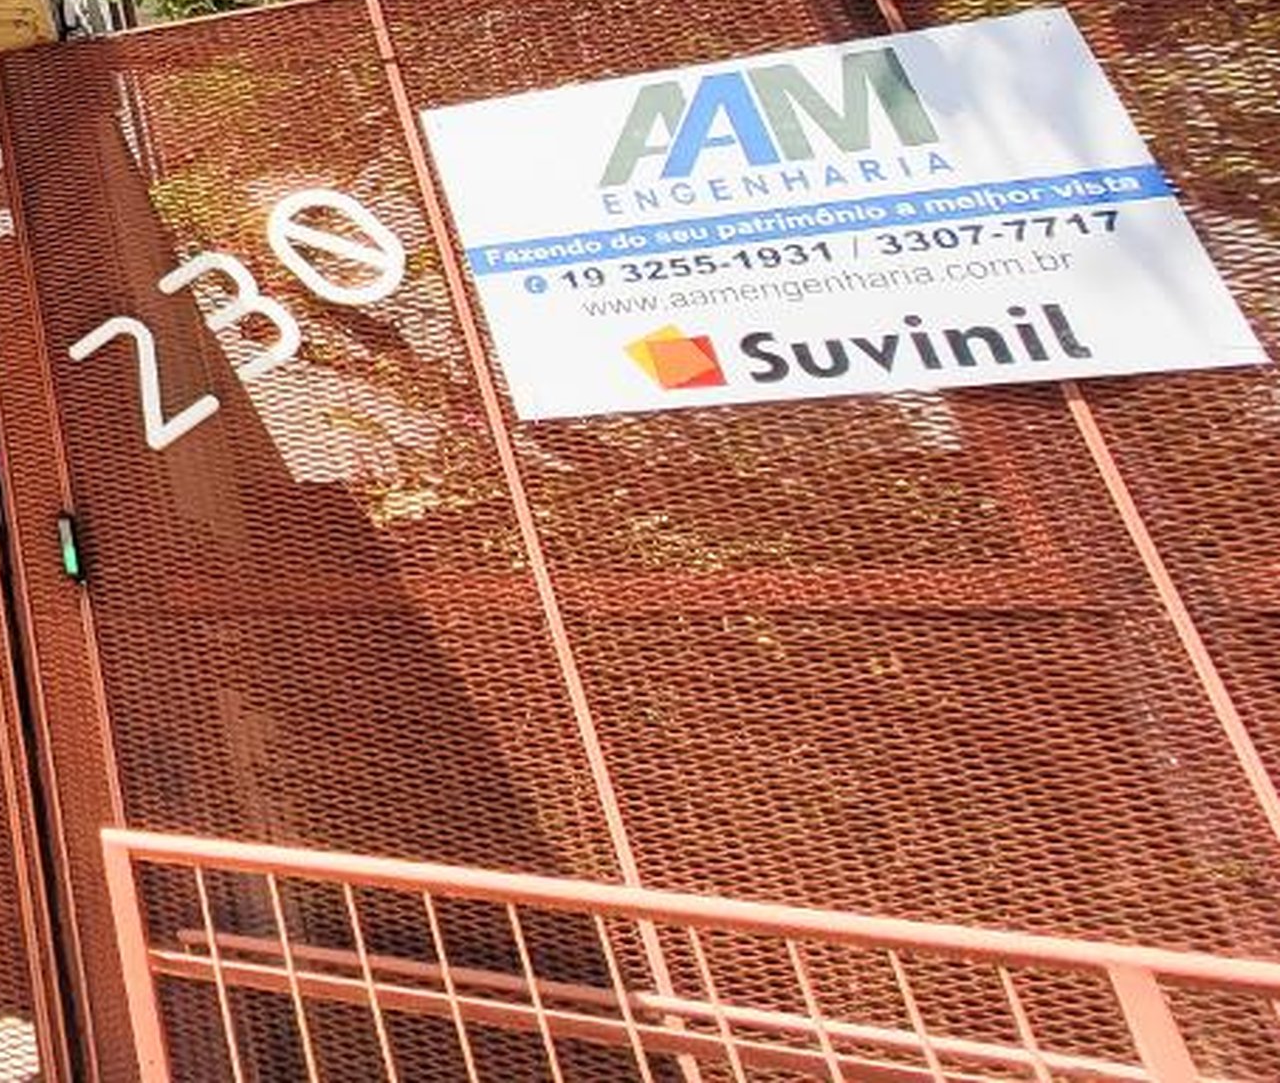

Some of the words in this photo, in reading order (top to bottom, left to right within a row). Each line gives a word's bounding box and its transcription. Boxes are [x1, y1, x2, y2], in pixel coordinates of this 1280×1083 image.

[598, 46, 939, 187] AAM
[485, 234, 603, 266] Fazendo
[610, 228, 647, 249] do
[655, 226, 709, 244] seu
[715, 202, 887, 242] patrimônio
[895, 197, 918, 217] a
[924, 188, 1044, 213] melhor
[1049, 174, 1142, 200] vista
[602, 150, 954, 215] ENGENHARIA
[561, 266, 605, 290] 19
[622, 241, 833, 283] 3255-1931
[877, 210, 1119, 256] 3307-7717
[584, 248, 1075, 318] www.aamengenharia.com.br
[67, 186, 407, 452] 230
[739, 303, 1093, 384] Suvinil
